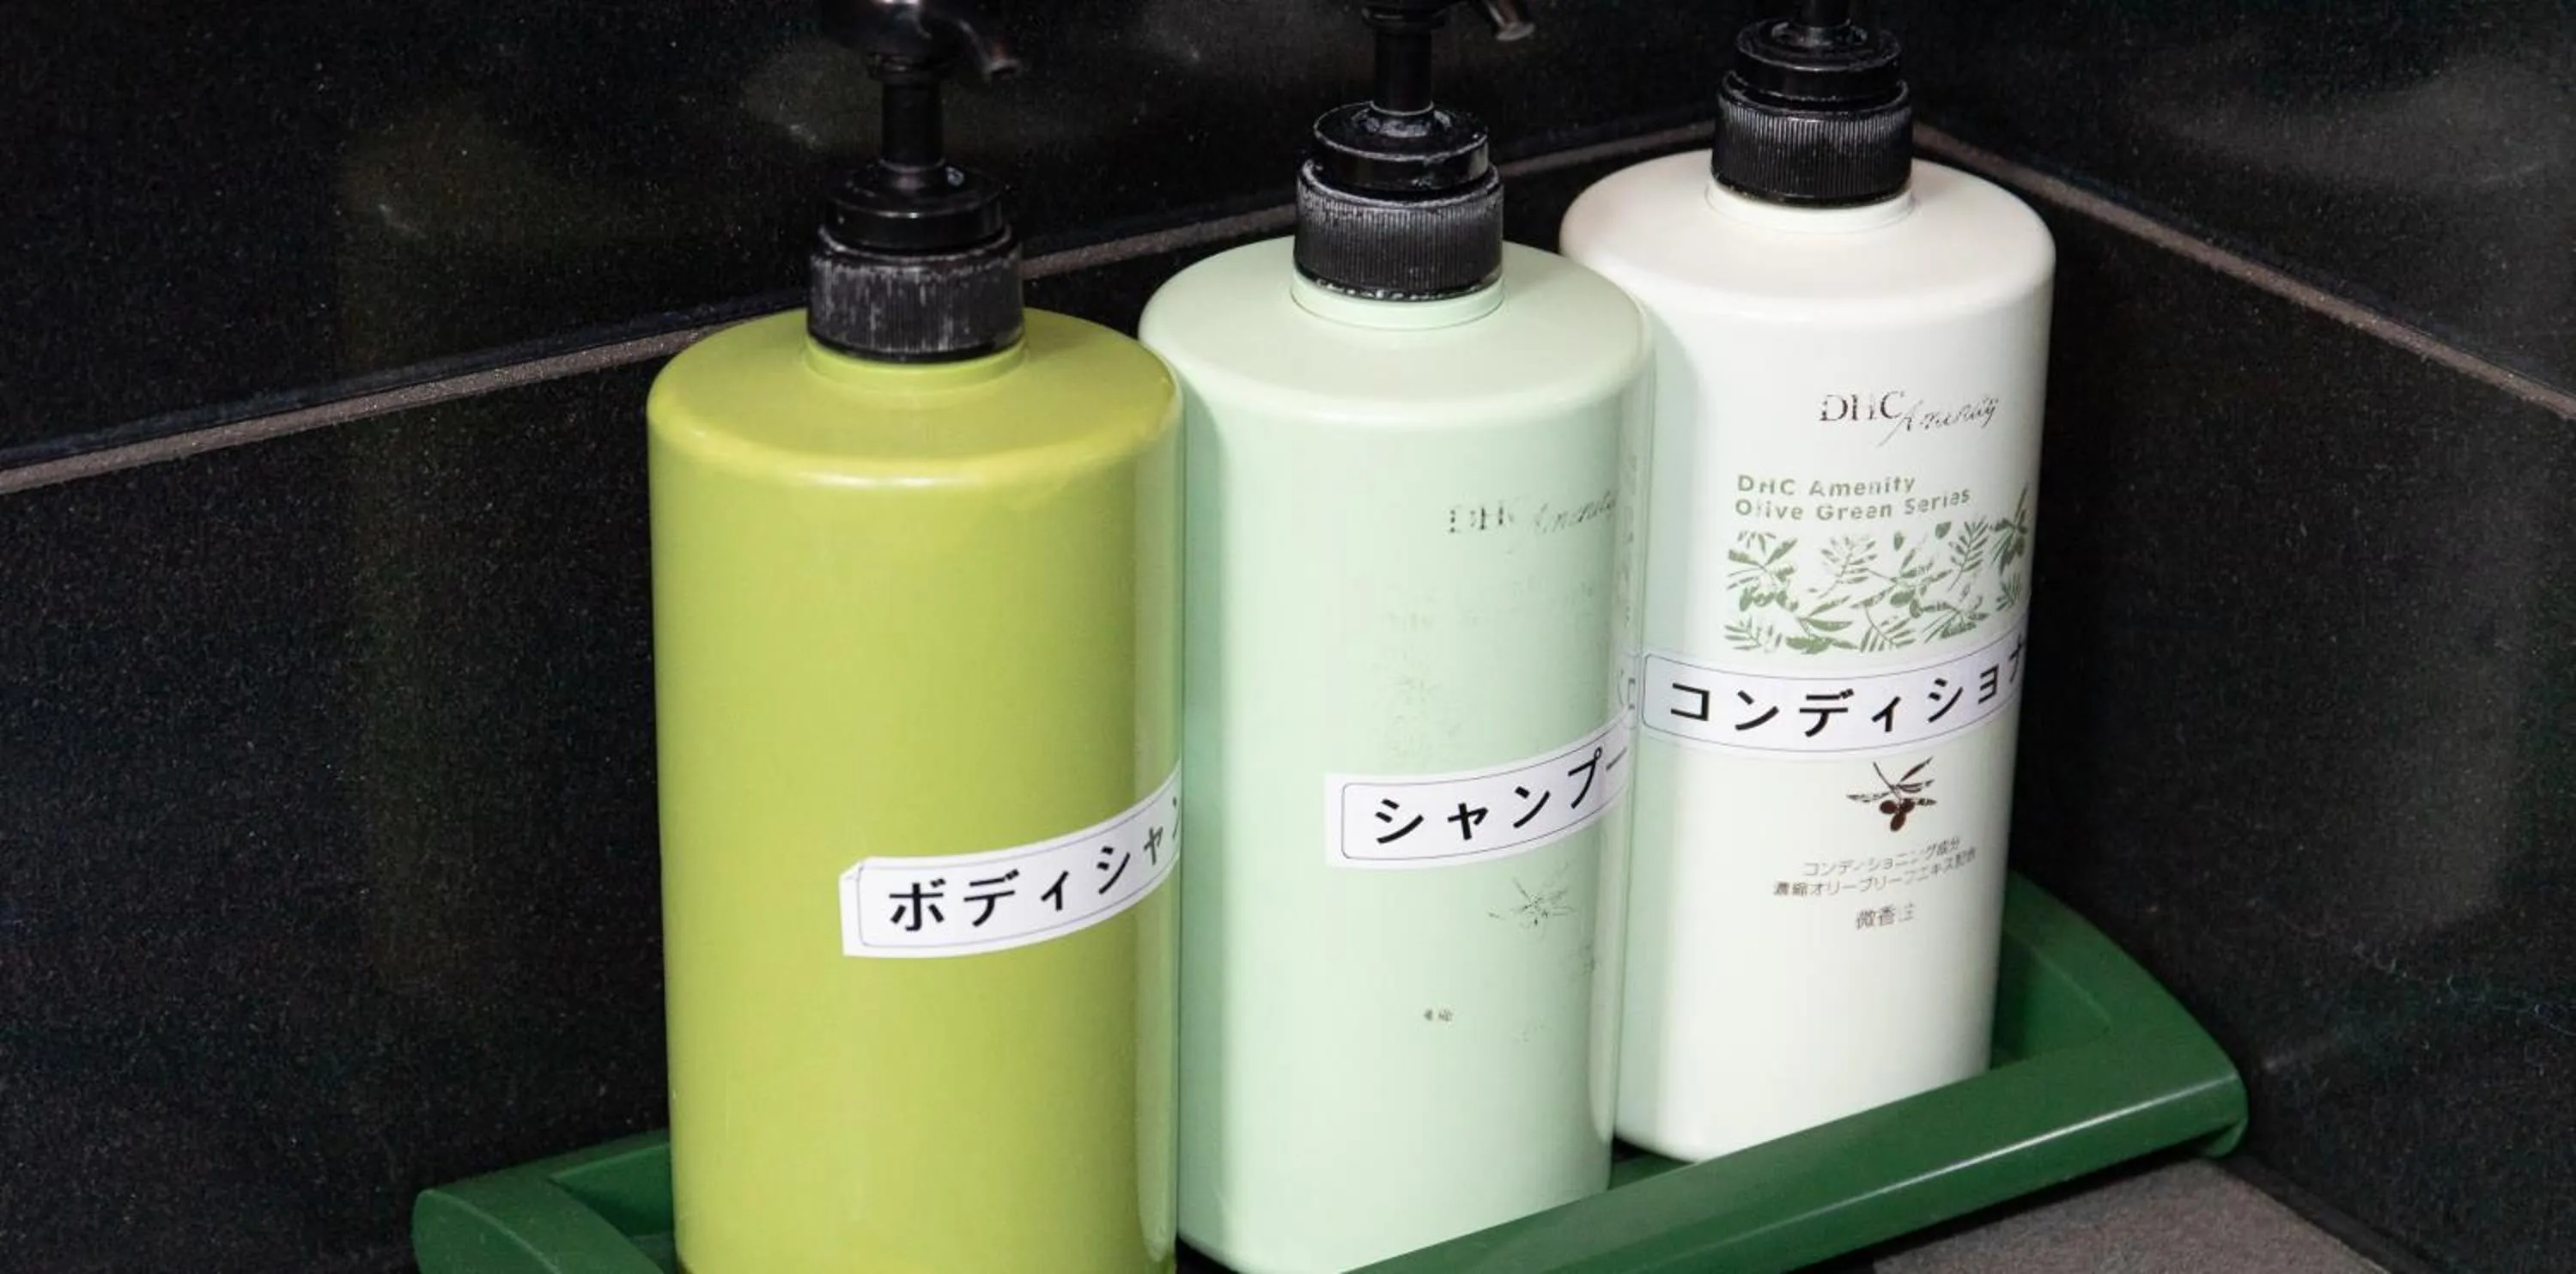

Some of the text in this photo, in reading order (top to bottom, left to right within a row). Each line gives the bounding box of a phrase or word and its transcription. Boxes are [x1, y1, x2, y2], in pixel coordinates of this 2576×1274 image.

[1820, 391, 1905, 421] DHC
[1737, 475, 1916, 496] DHC Amenity
[1735, 488, 1971, 520] Oive Green Series
[1376, 747, 1627, 845] シャンプー
